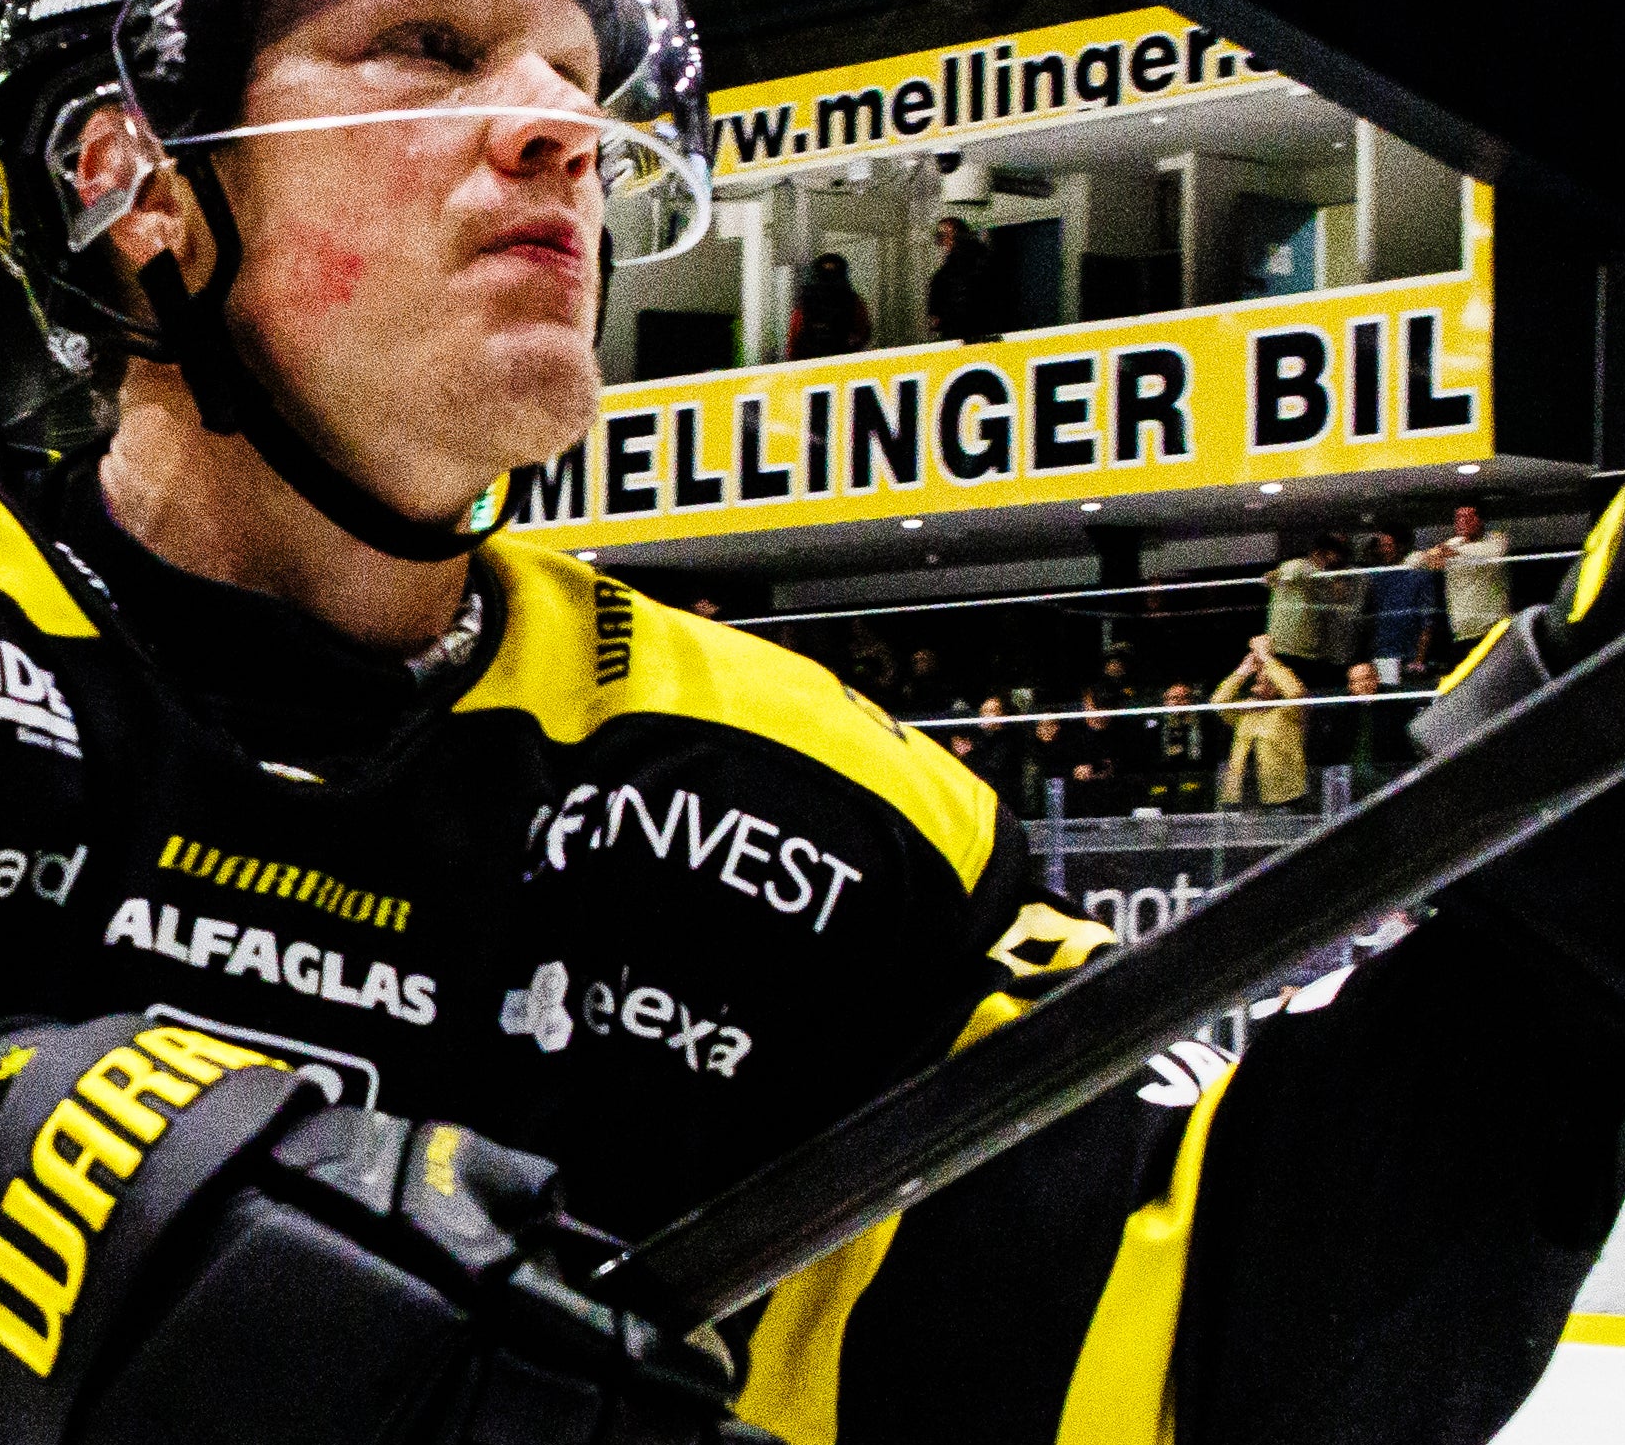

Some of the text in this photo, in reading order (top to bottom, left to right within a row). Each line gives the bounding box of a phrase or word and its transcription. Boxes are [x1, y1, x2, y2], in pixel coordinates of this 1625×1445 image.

[515, 310, 1475, 527] MELLINGER BIL
[156, 835, 412, 934] WARRIOR
[103, 898, 438, 1027] ALFAGLAS
